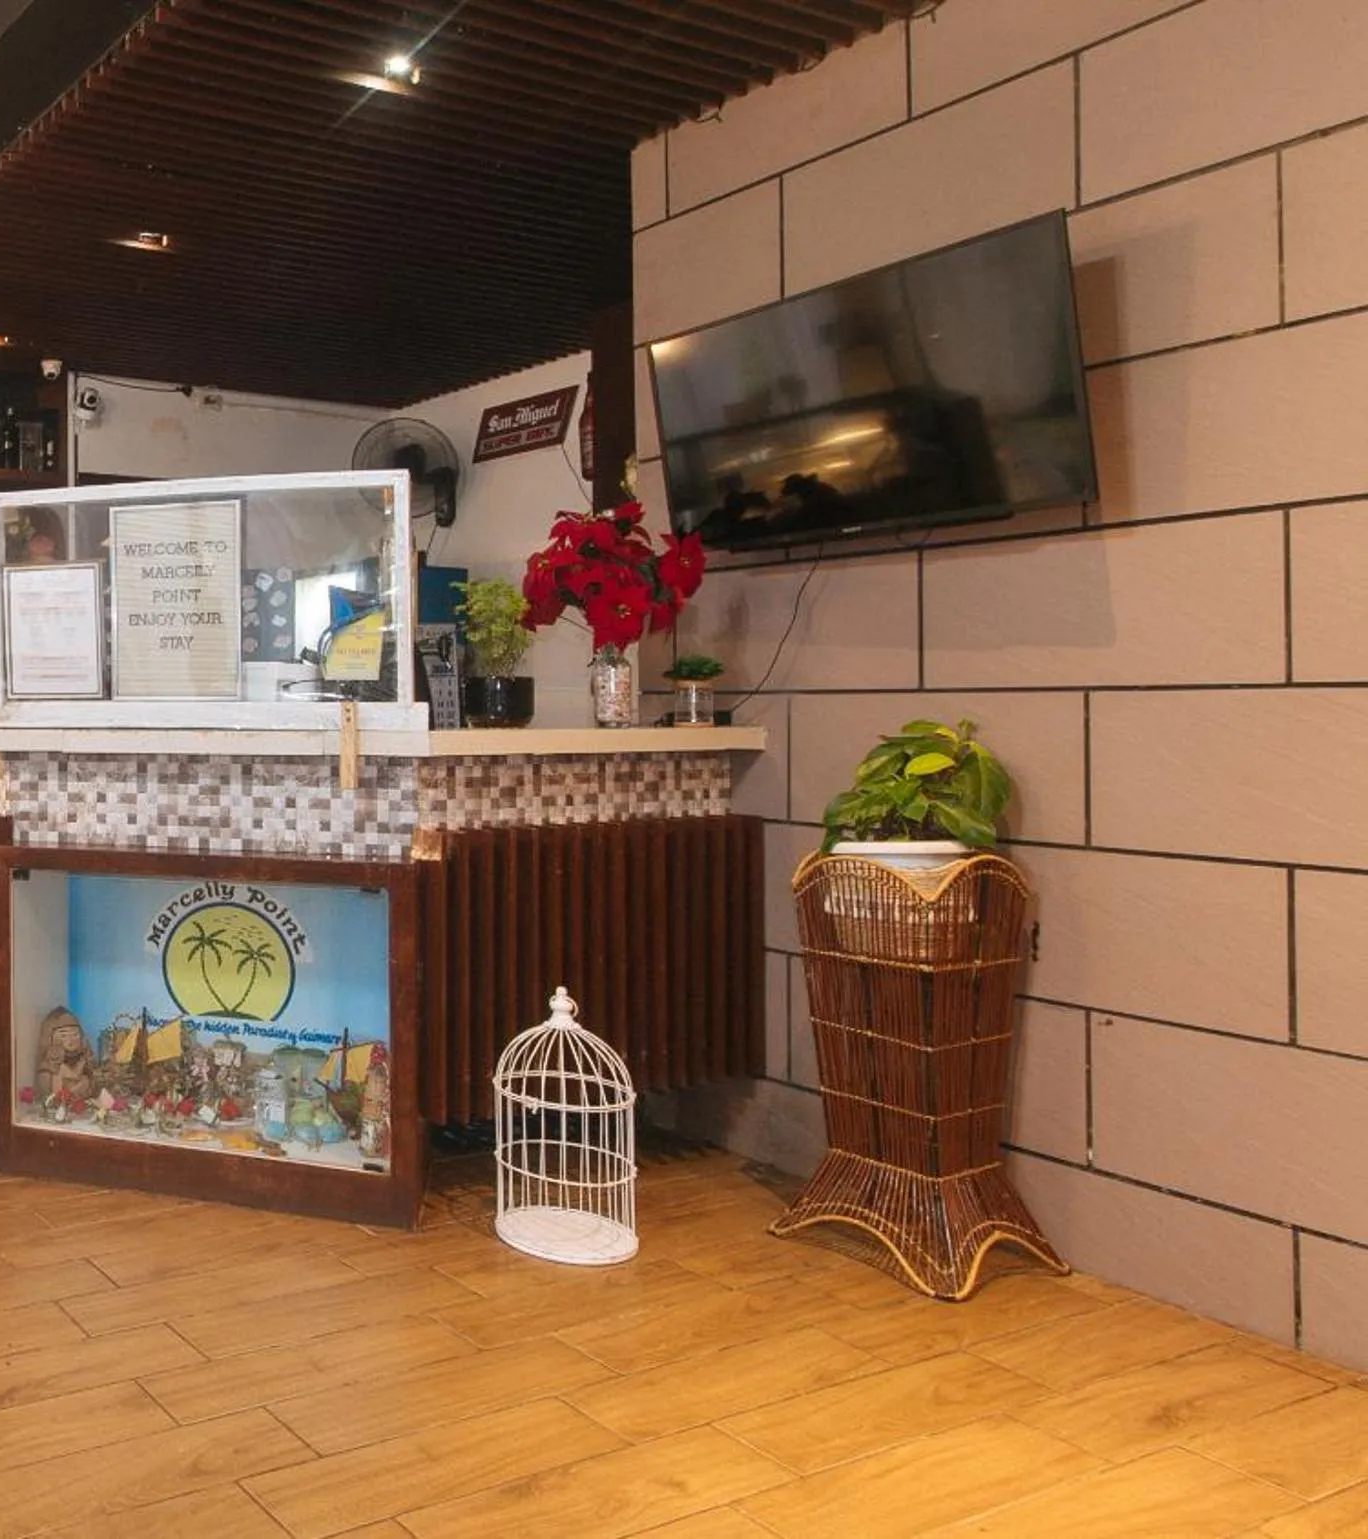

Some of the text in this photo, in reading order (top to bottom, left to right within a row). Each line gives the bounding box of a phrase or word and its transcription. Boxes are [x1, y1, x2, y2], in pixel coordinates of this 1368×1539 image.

[487, 398, 560, 433] San Miguel
[123, 540, 228, 556] WELCOME TO
[152, 588, 202, 604] POINT
[128, 611, 224, 626] ENJOY YOUR
[159, 635, 194, 650] STAY
[147, 880, 307, 954] Marcelly Point
